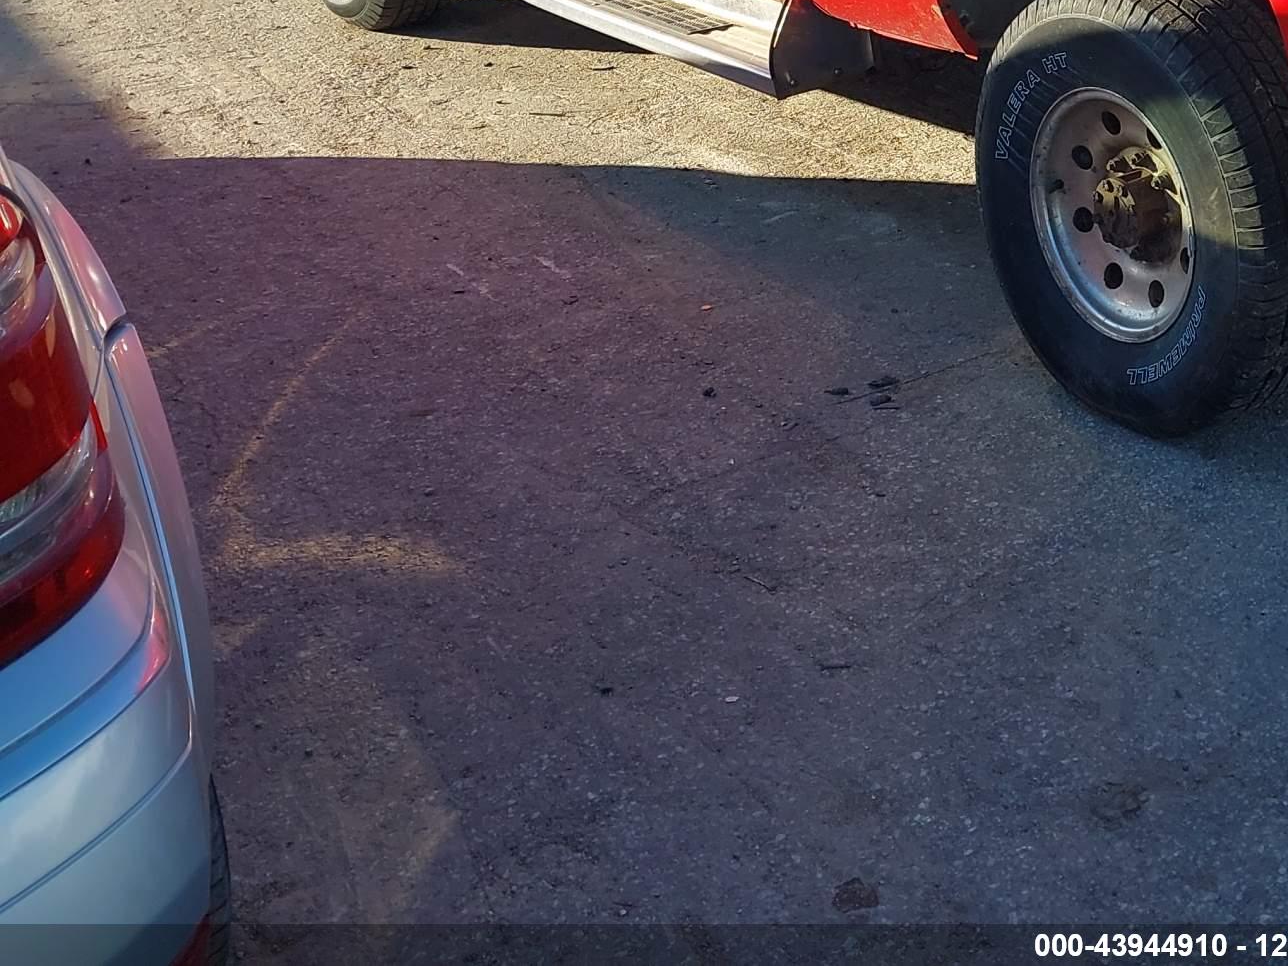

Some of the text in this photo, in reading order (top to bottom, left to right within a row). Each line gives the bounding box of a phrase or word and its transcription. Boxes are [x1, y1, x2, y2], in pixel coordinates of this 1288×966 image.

[995, 52, 1067, 160] VALERA HT
[1126, 284, 1206, 386] PRIMEWELL
